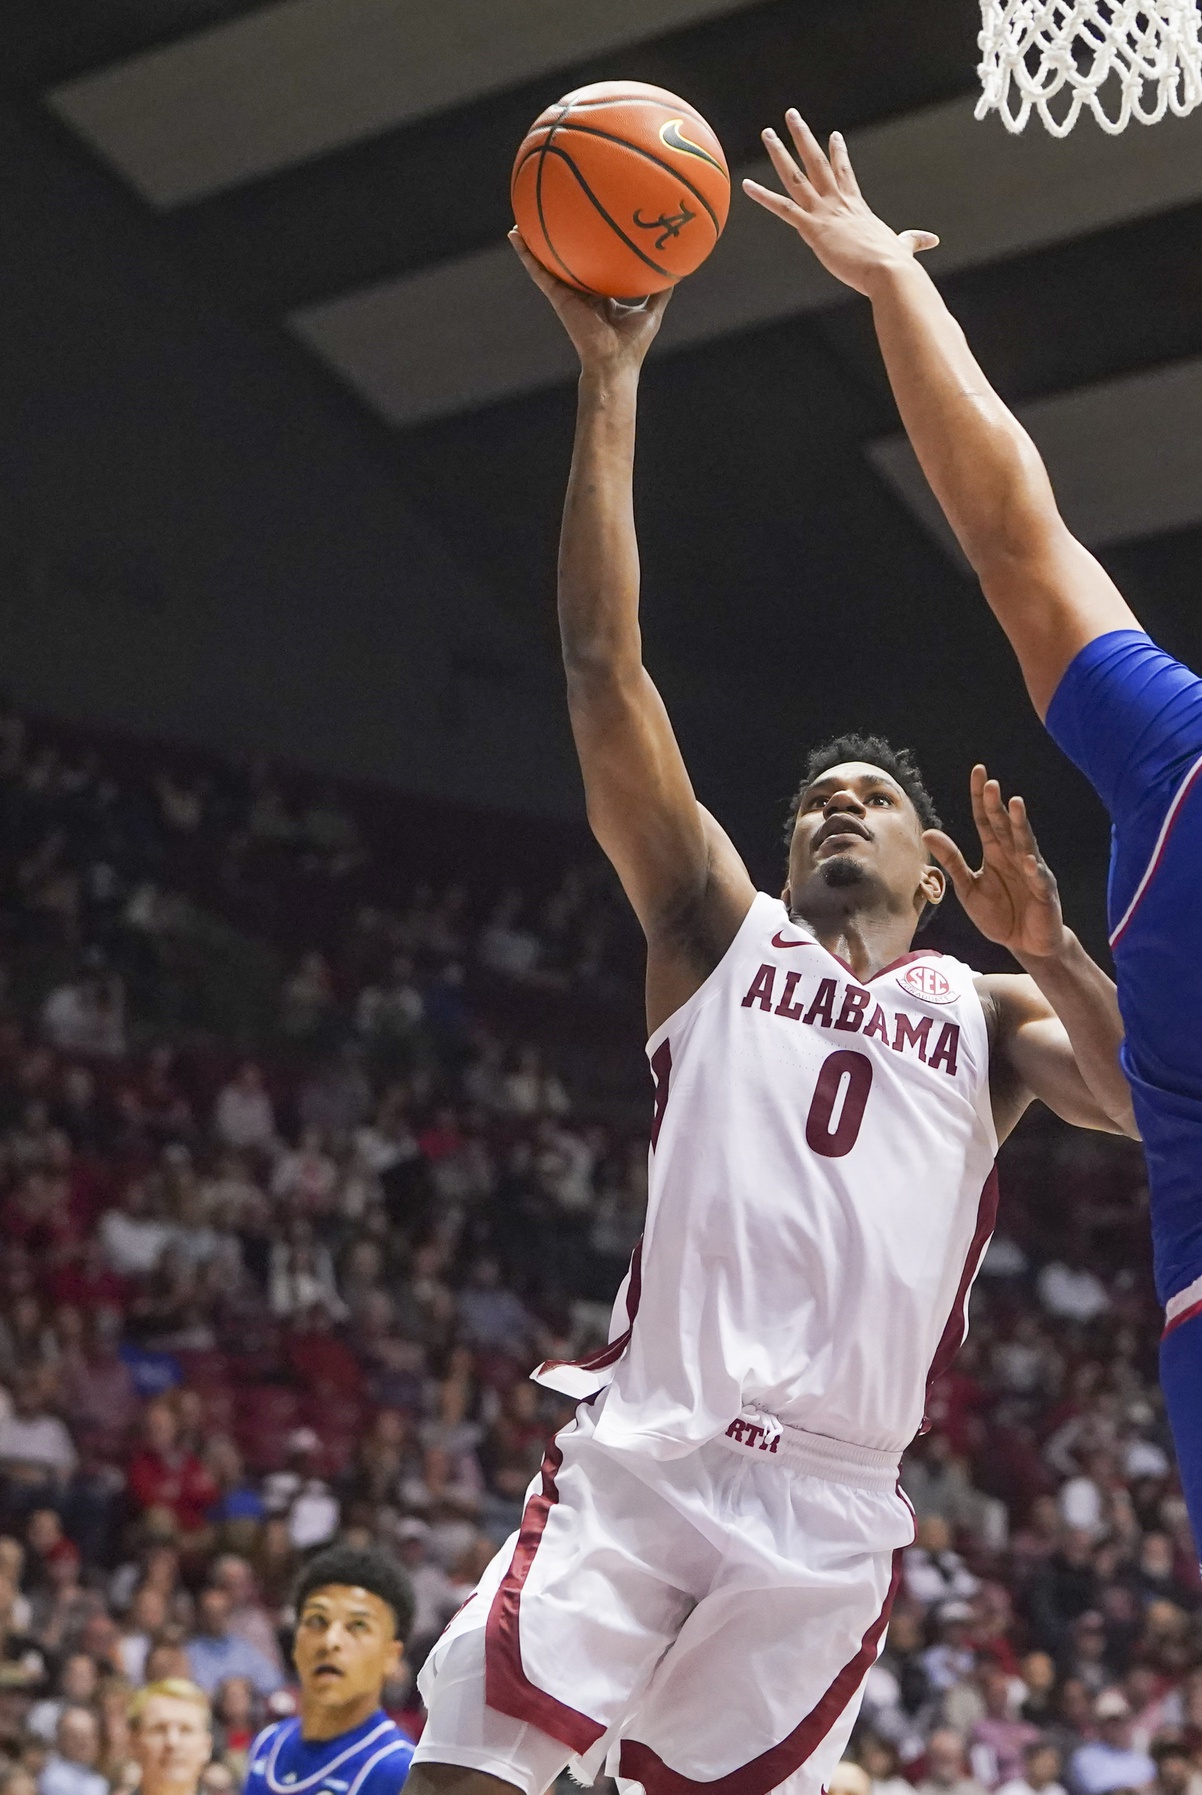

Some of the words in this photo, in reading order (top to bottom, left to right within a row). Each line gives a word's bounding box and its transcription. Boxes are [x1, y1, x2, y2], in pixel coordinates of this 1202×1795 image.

[741, 964, 960, 1076] ALABAMA
[907, 966, 949, 995] SEC
[805, 1050, 873, 1157] 0
